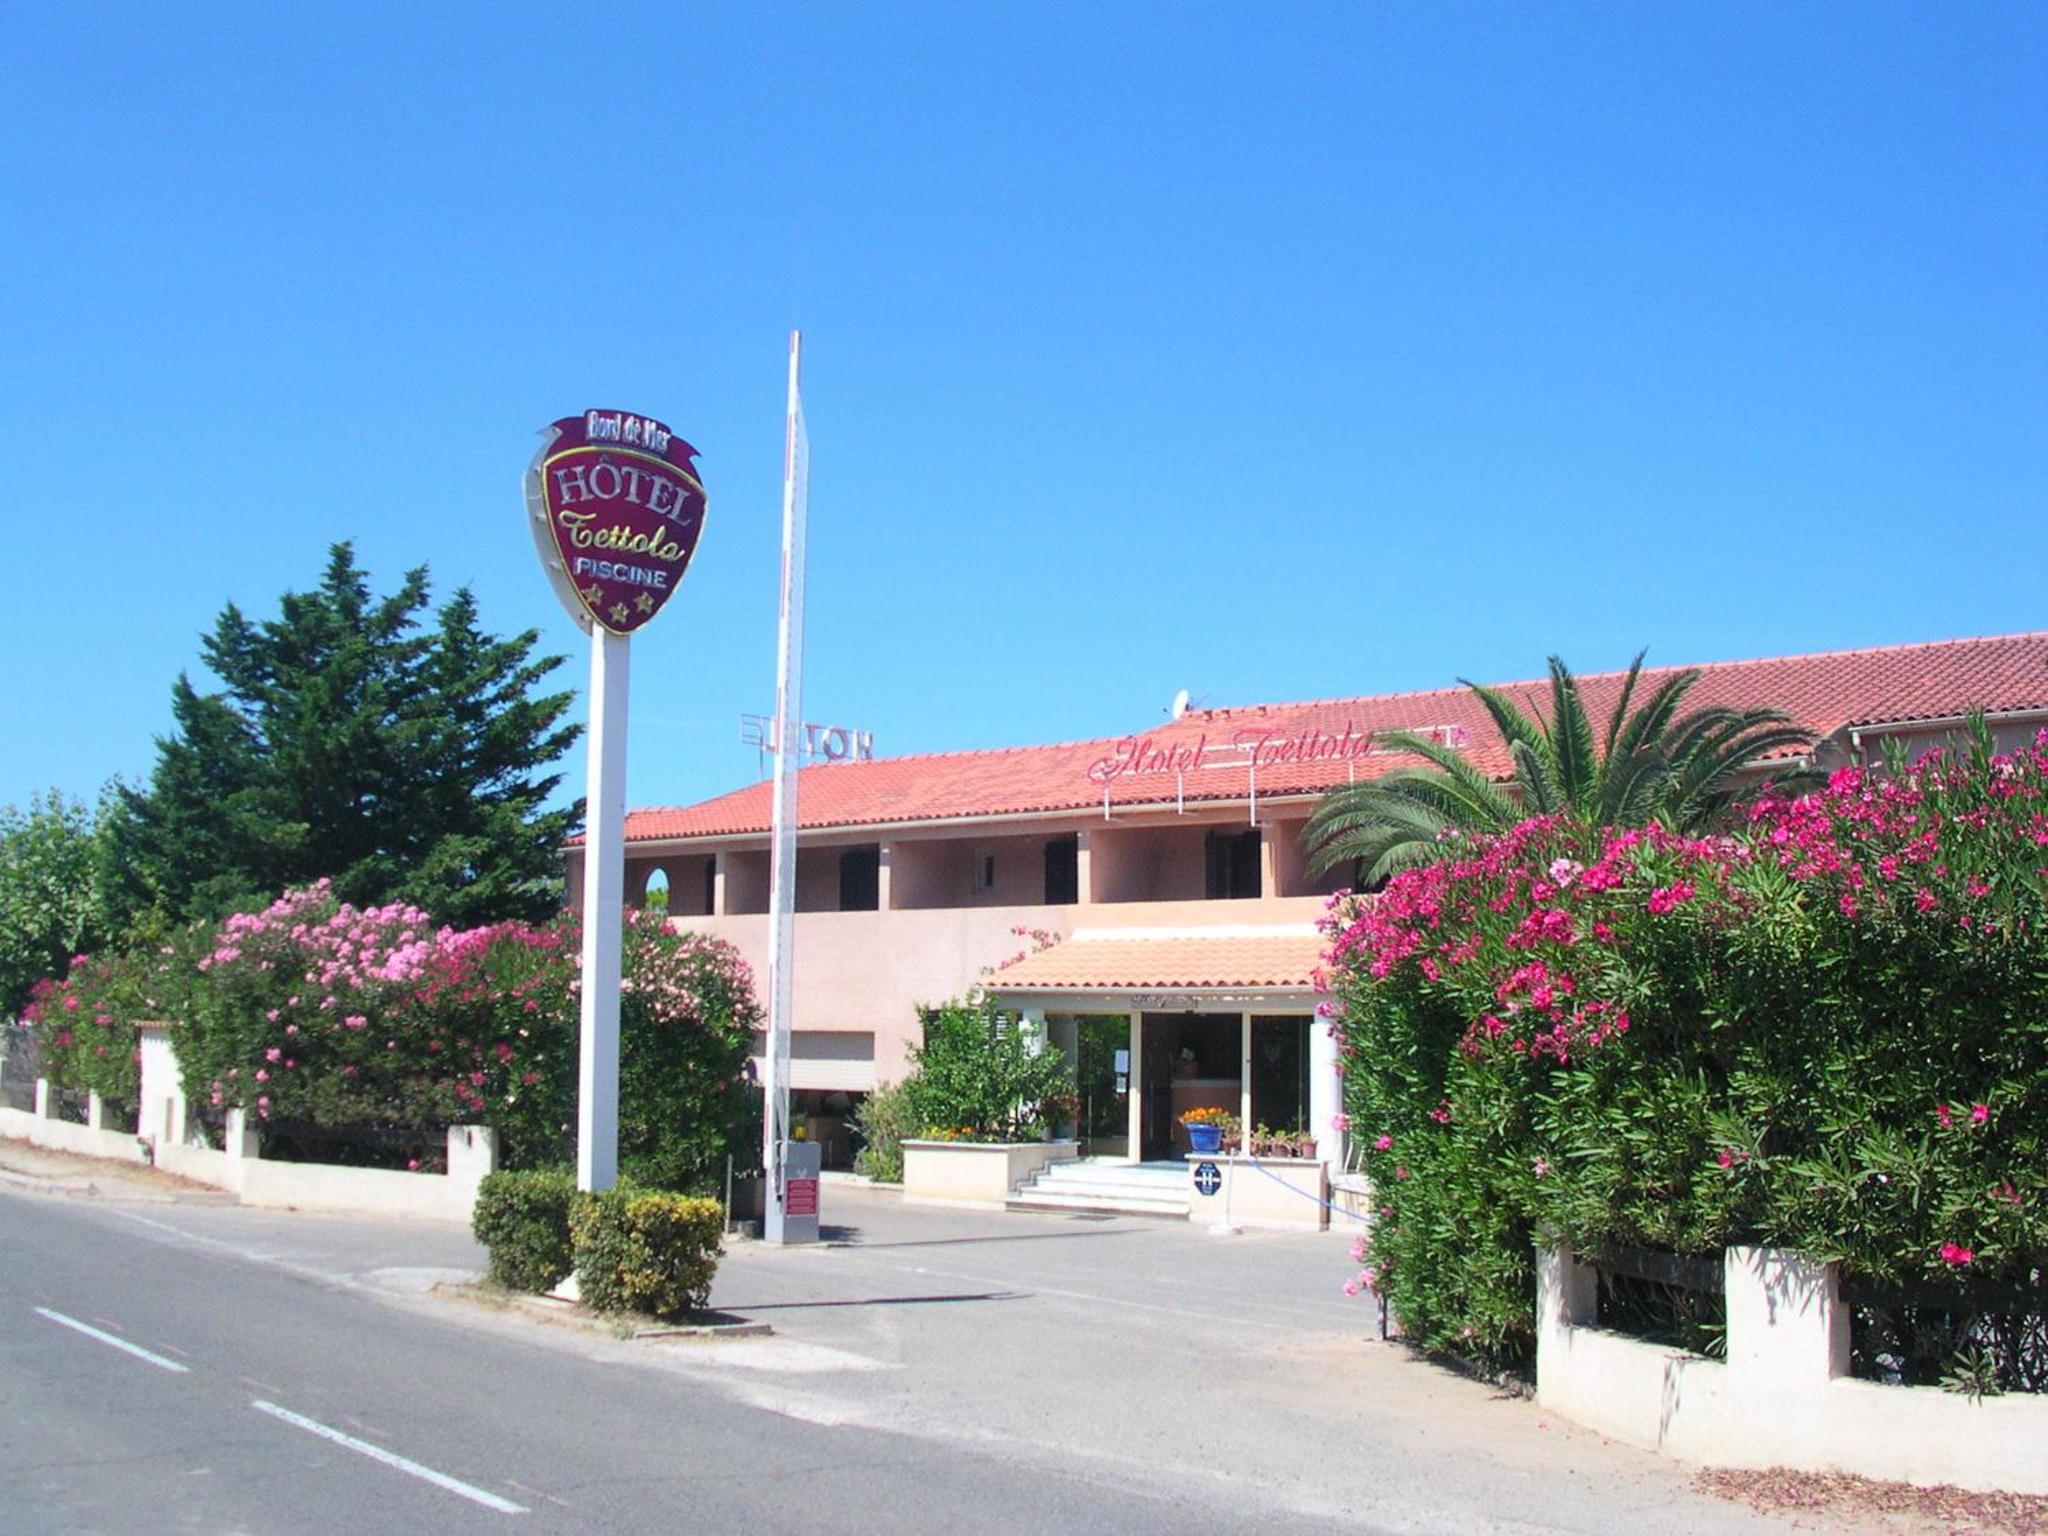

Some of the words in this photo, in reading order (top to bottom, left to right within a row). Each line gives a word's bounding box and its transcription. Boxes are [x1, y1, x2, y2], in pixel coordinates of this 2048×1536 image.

[586, 411, 621, 441] Bord
[623, 415, 641, 444] de
[642, 420, 671, 454] Mer
[554, 454, 692, 526] HÔTEL
[558, 509, 686, 562] Tettola
[573, 556, 668, 589] PISCINE
[1087, 733, 1205, 786] Hotel
